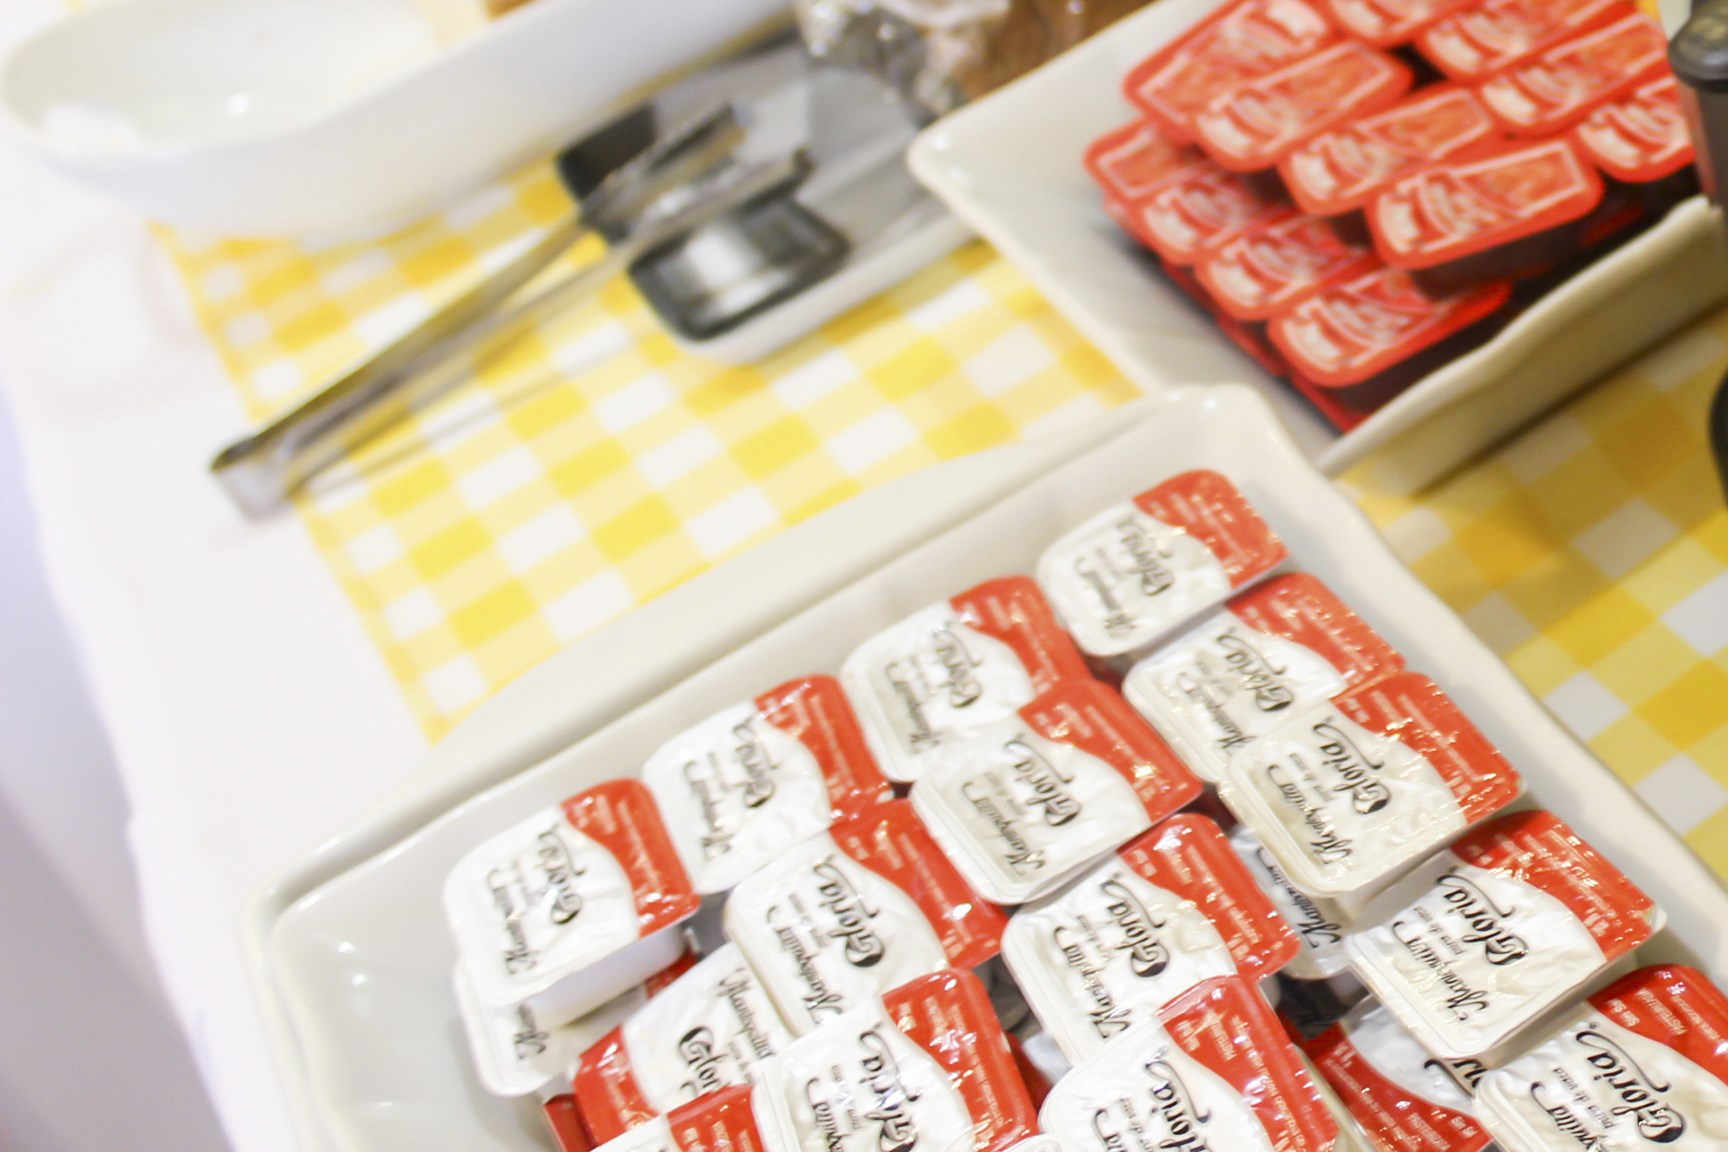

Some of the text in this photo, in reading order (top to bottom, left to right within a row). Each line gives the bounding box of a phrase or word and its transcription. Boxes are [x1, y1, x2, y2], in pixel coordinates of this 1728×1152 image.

[1216, 634, 1294, 713] Gloria
[1004, 739, 1082, 827] Gloria
[1312, 722, 1391, 815] Gloria
[813, 862, 886, 968] Gloria
[1099, 879, 1171, 978] Gloria
[1436, 874, 1529, 966] Gloria
[679, 1025, 731, 1098] Glor
[1552, 1066, 1620, 1130] pura de vaca
[1575, 1030, 1687, 1144] Gloria
